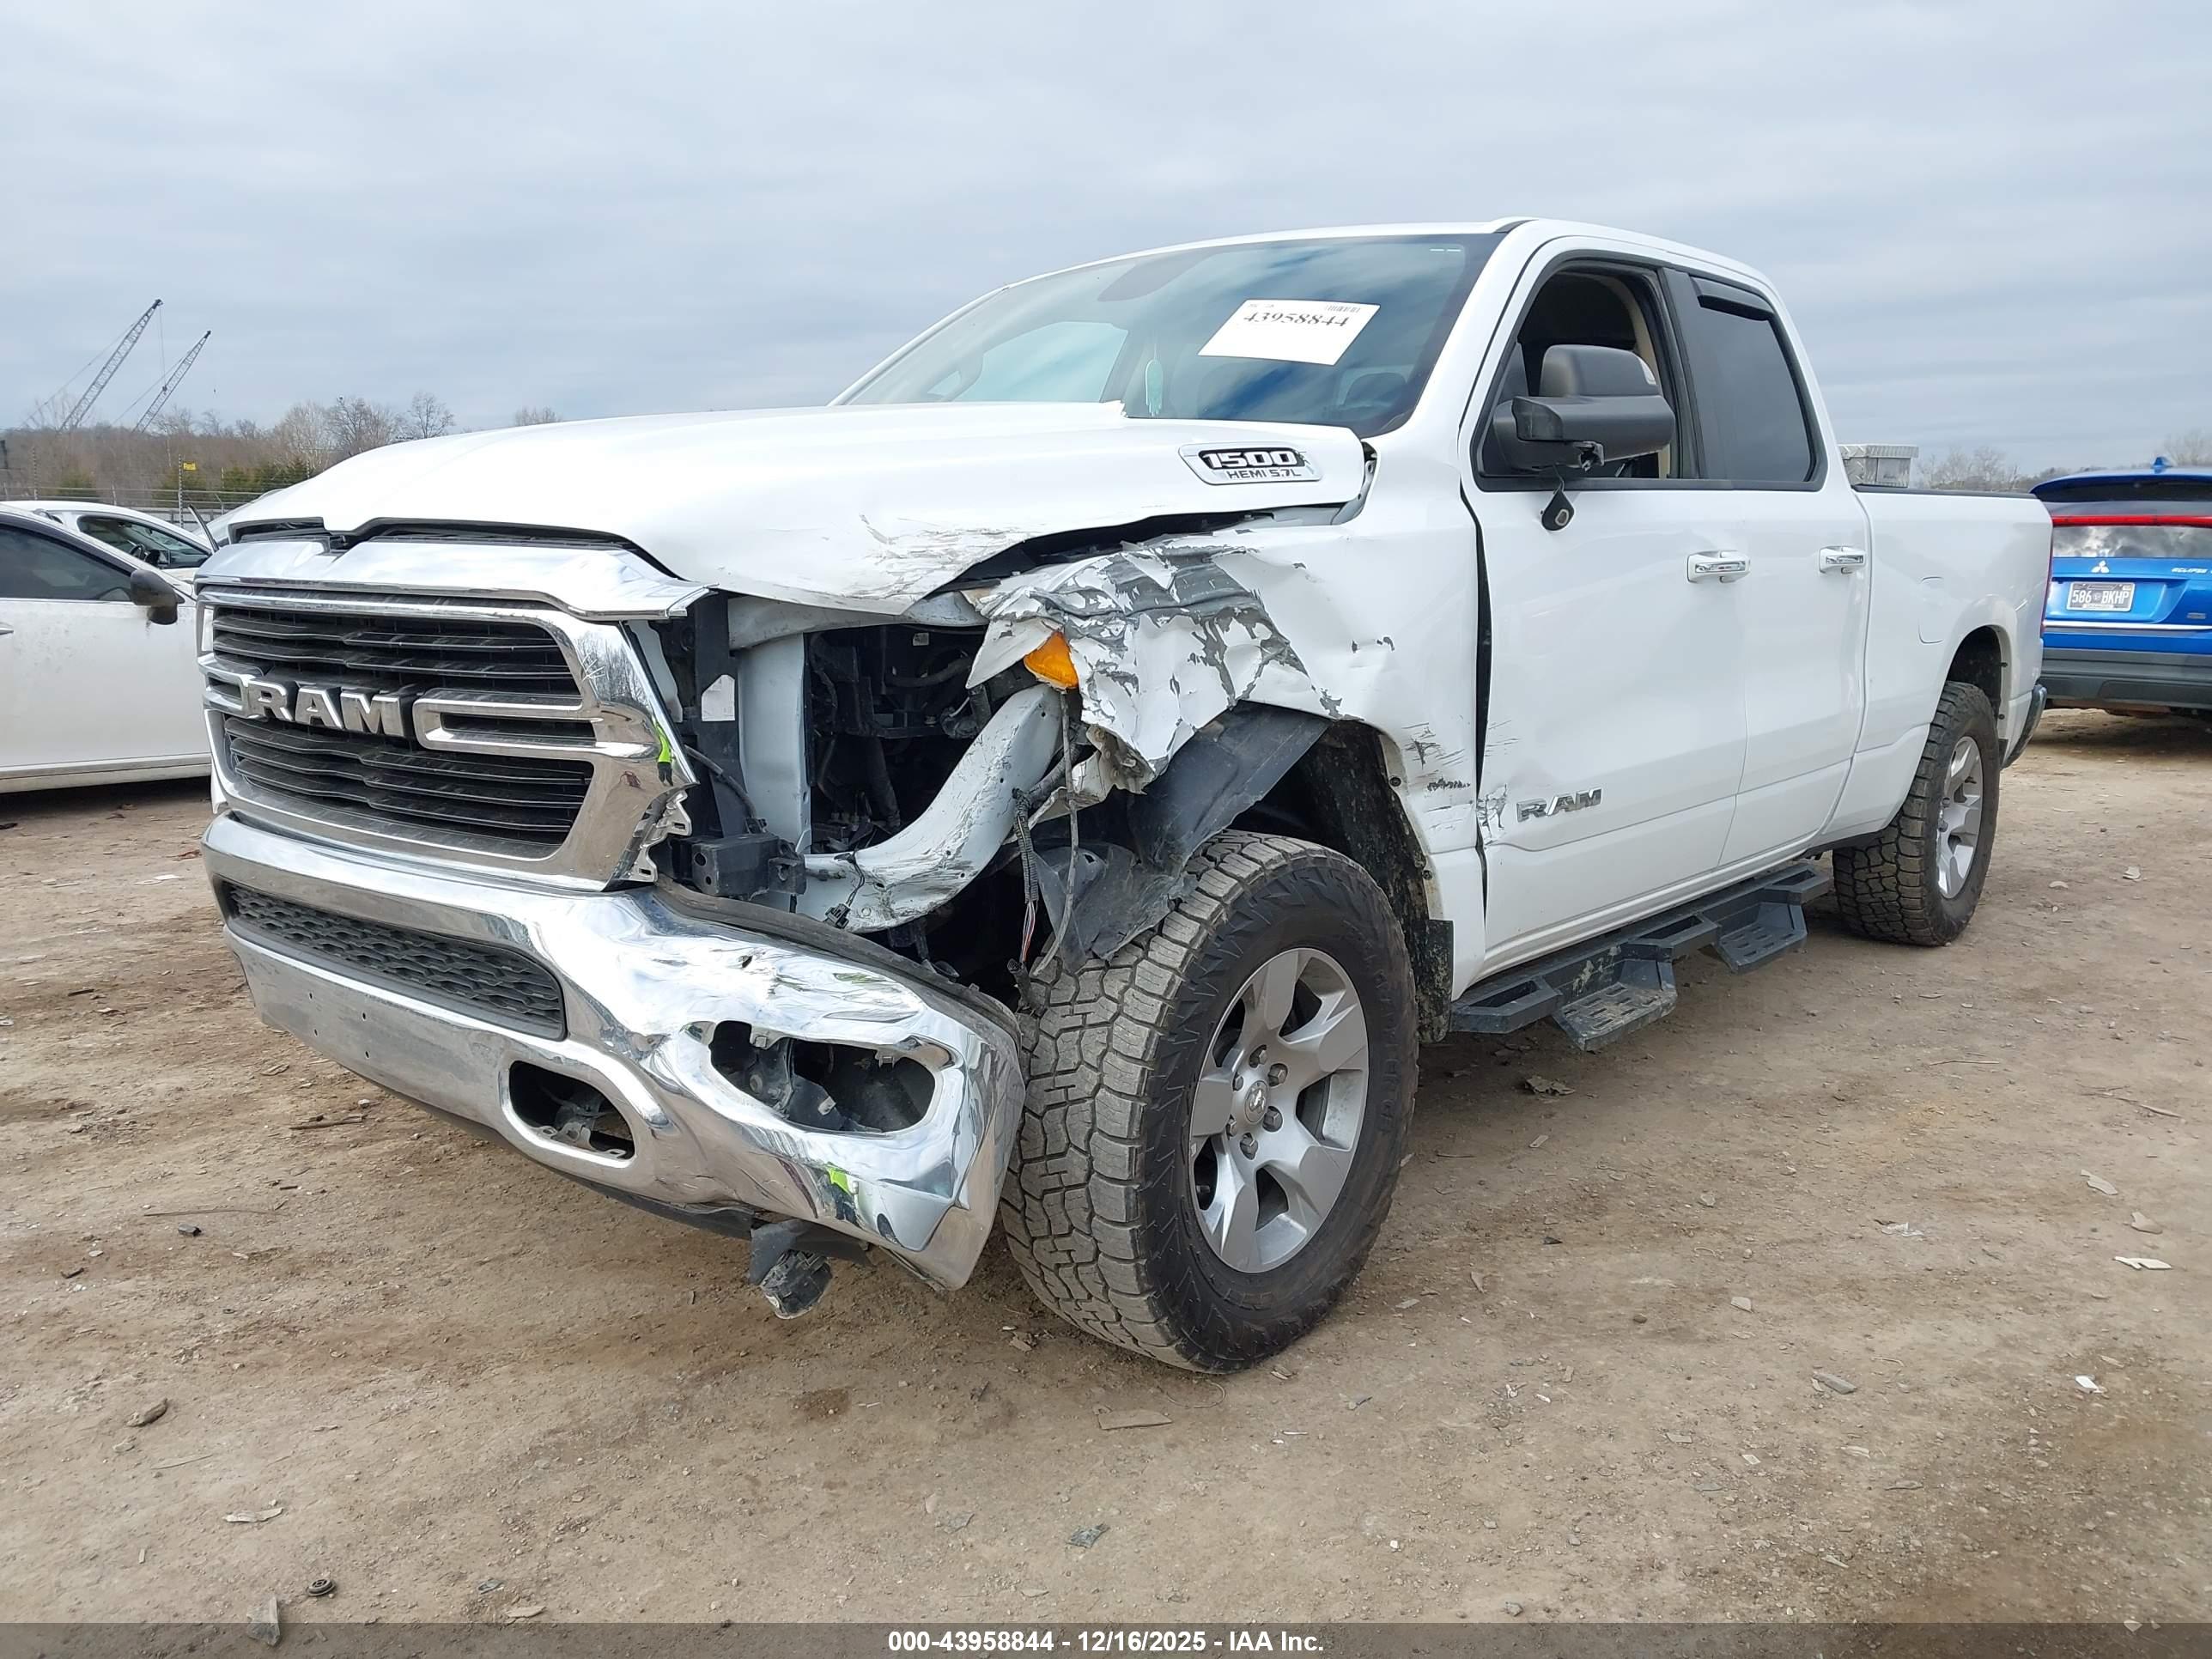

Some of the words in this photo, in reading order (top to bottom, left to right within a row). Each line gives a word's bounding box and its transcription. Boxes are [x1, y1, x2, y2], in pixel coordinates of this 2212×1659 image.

[1243, 311, 1350, 327] 43958844
[1202, 451, 1297, 468] 1500
[1226, 471, 1268, 479] HEMI
[1270, 469, 1302, 477] 5.7L
[2072, 590, 2092, 604] 586
[2101, 591, 2130, 605] BKHP
[246, 679, 404, 738] RAM
[1516, 787, 1601, 823] RAM
